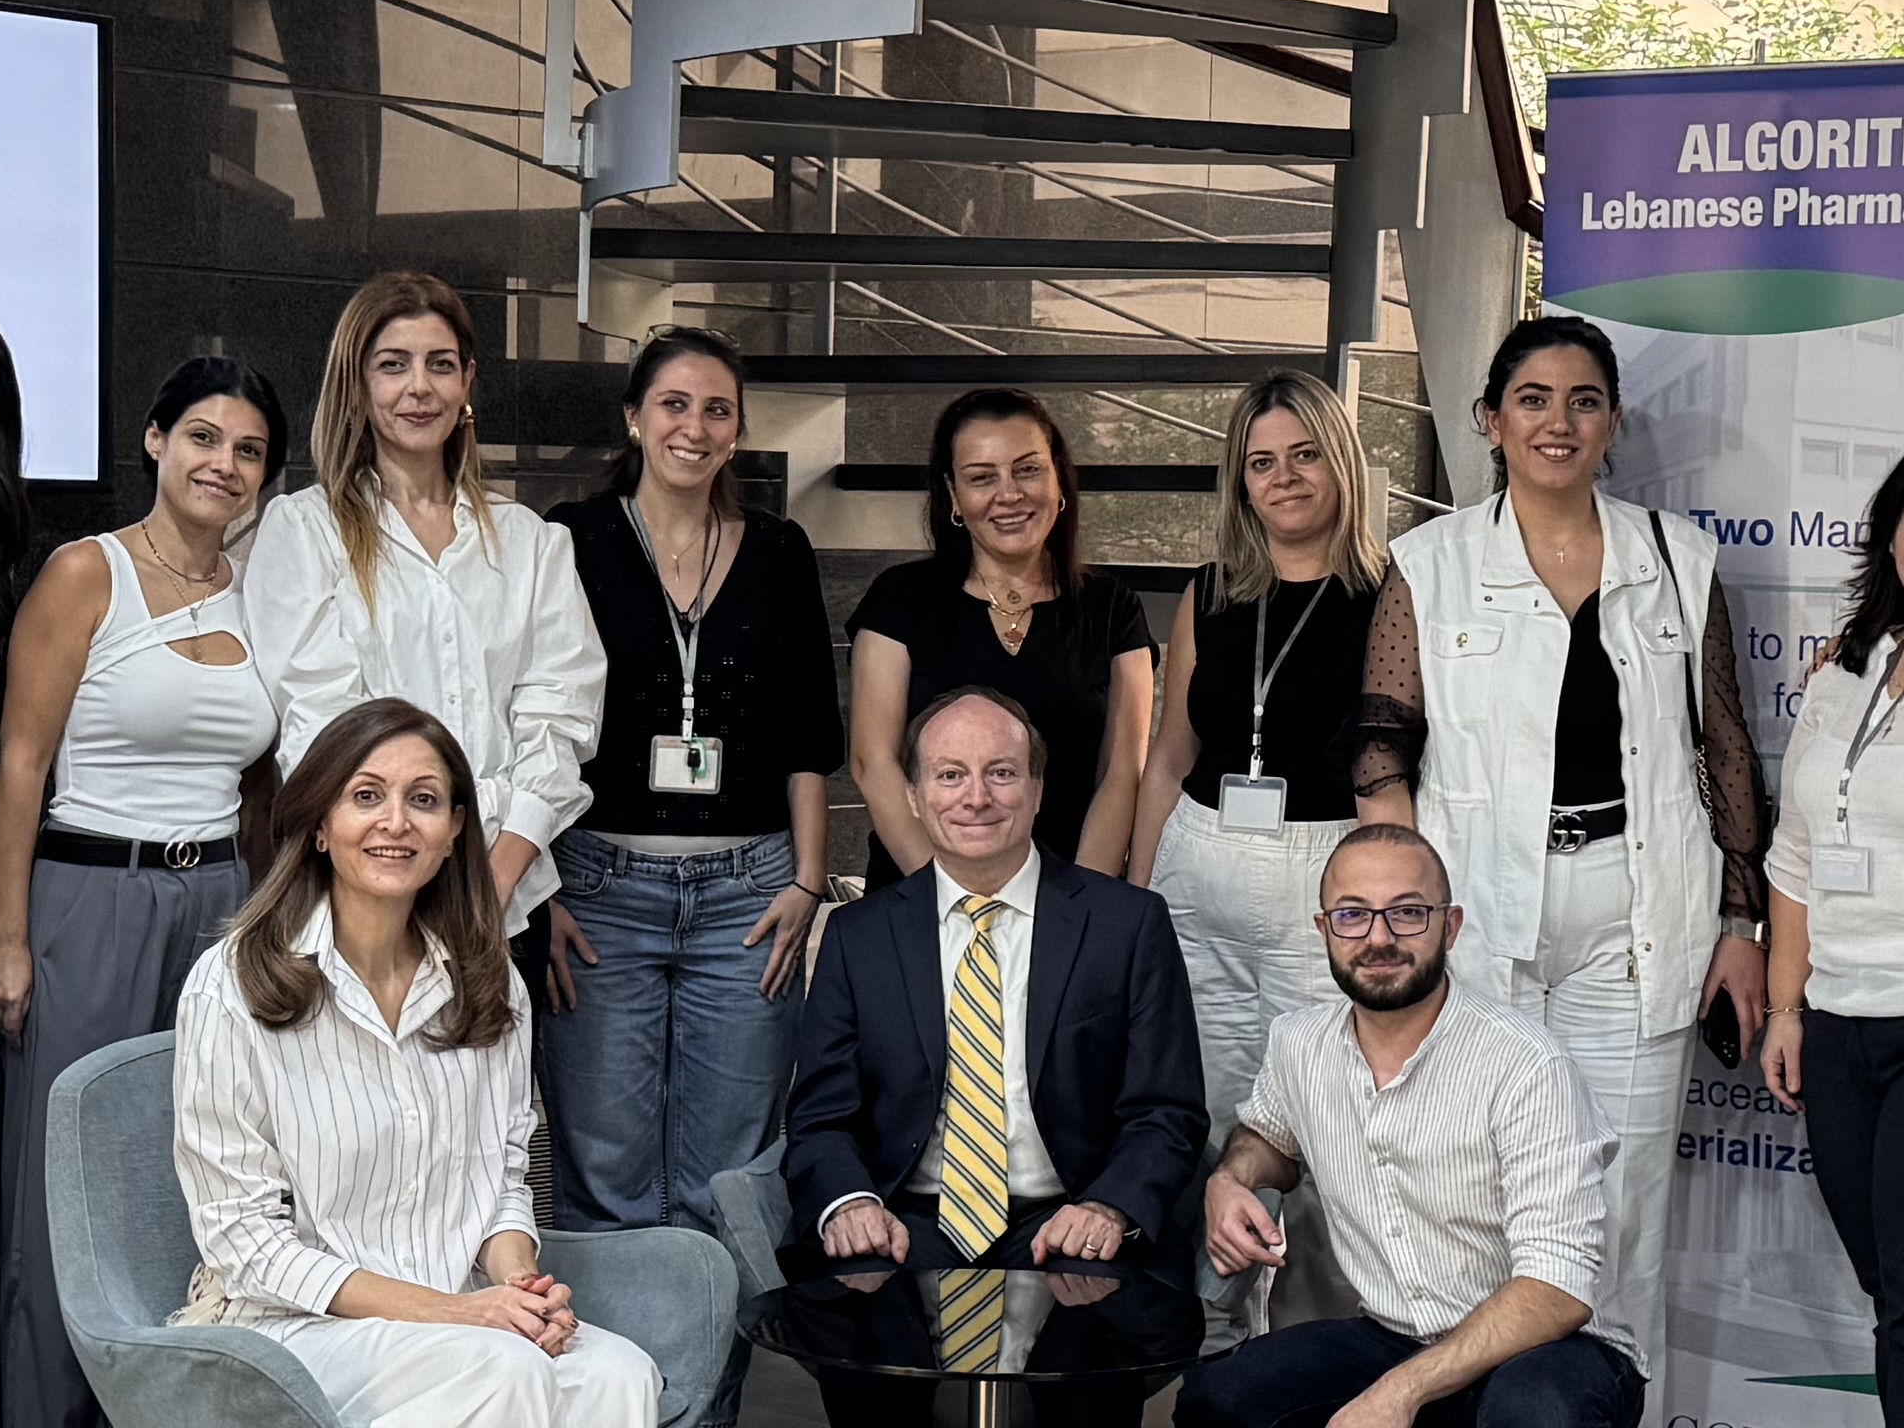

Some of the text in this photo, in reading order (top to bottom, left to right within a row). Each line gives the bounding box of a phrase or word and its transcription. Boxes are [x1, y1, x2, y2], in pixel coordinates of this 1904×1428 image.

[1582, 190, 1764, 231] Lebanese
[1688, 509, 1775, 547] Two
[1748, 626, 1783, 661] to
